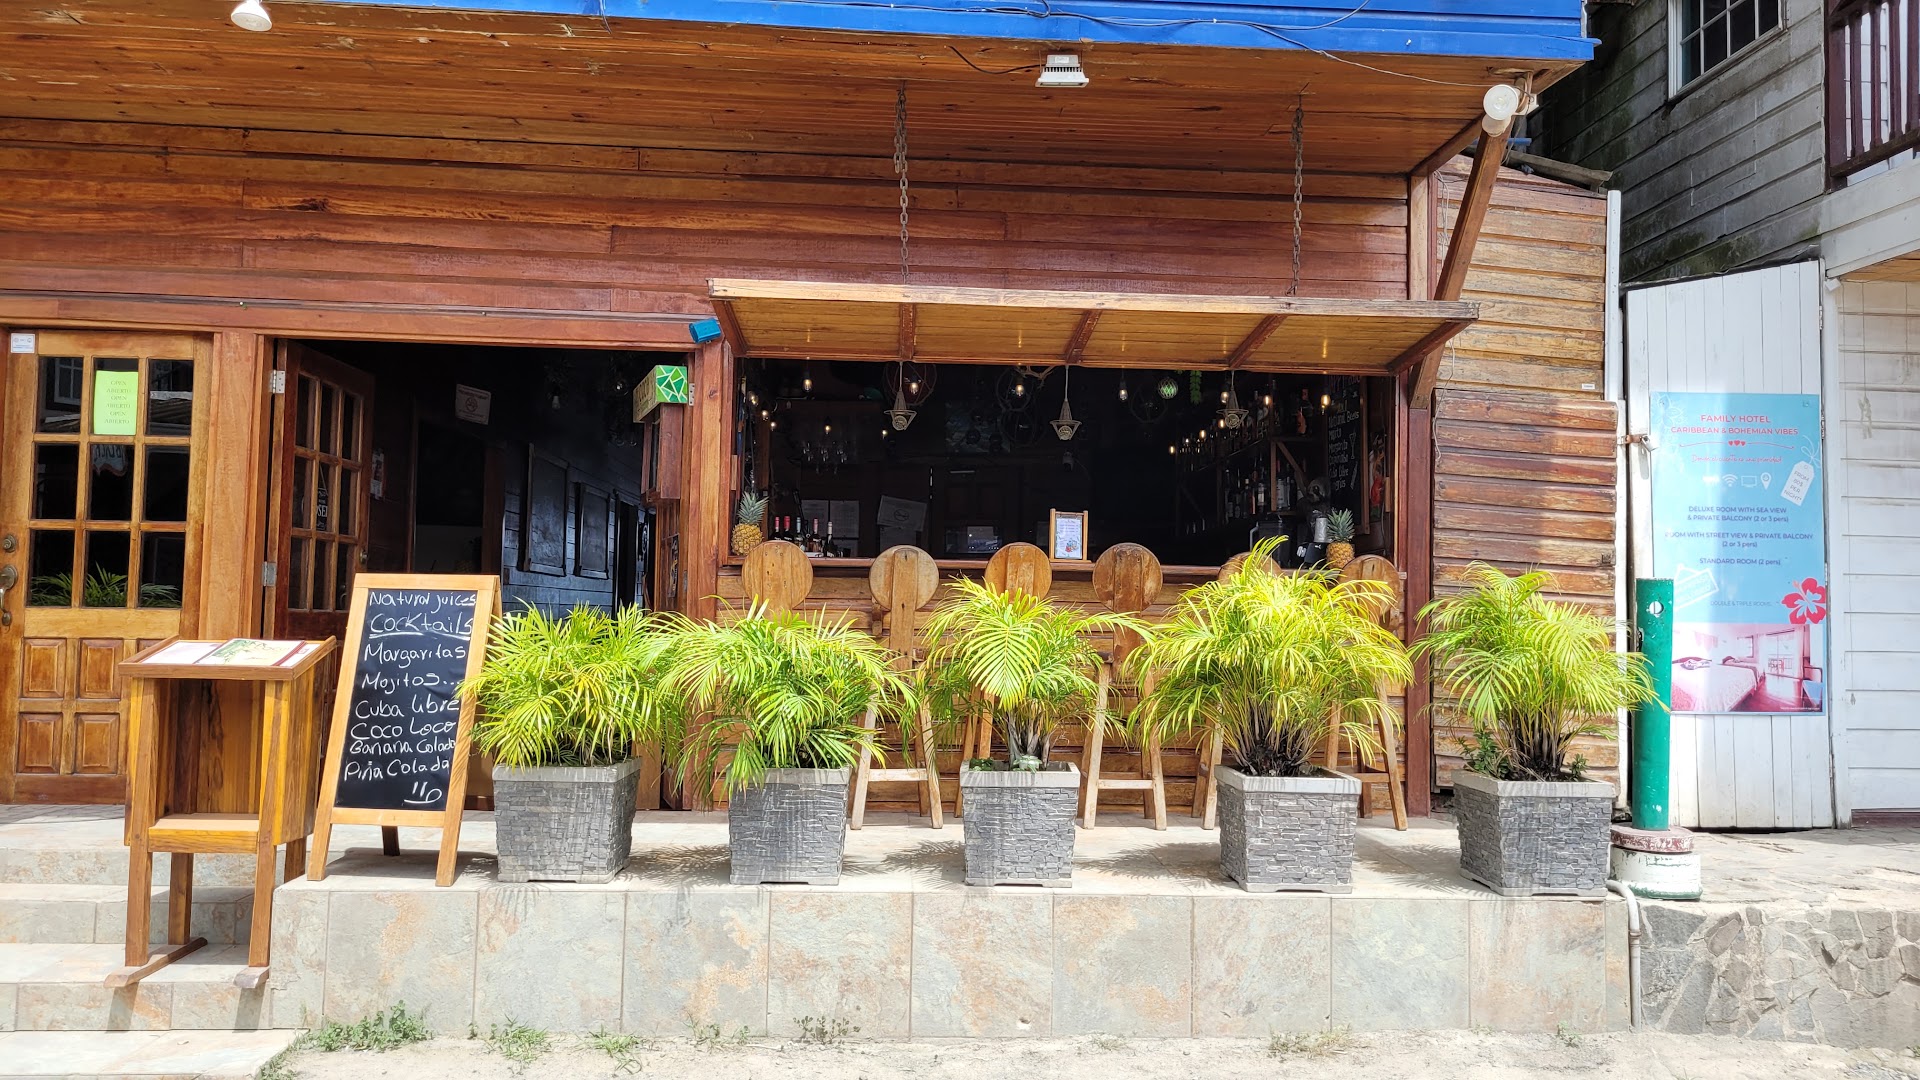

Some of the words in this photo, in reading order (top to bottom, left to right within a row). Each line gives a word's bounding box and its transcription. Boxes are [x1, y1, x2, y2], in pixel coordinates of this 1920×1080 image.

[1701, 415, 1736, 423] FAMILY
[1739, 415, 1770, 424] HOTEL
[1671, 426, 1719, 434] CARIBBEAN
[1728, 427, 1773, 435] BOHEMIAN
[1789, 485, 1801, 493] PER
[1753, 515, 1760, 523] (2
[369, 591, 431, 607] Natural
[431, 592, 477, 614] juices
[370, 611, 474, 635] Cocktails
[364, 642, 466, 669] Margaritas
[355, 700, 405, 719] Cuba
[351, 722, 403, 740] Coco
[409, 717, 457, 735] Loco
[350, 740, 413, 756] Banana
[344, 760, 384, 781] Piña
[387, 756, 450, 777] Colada
